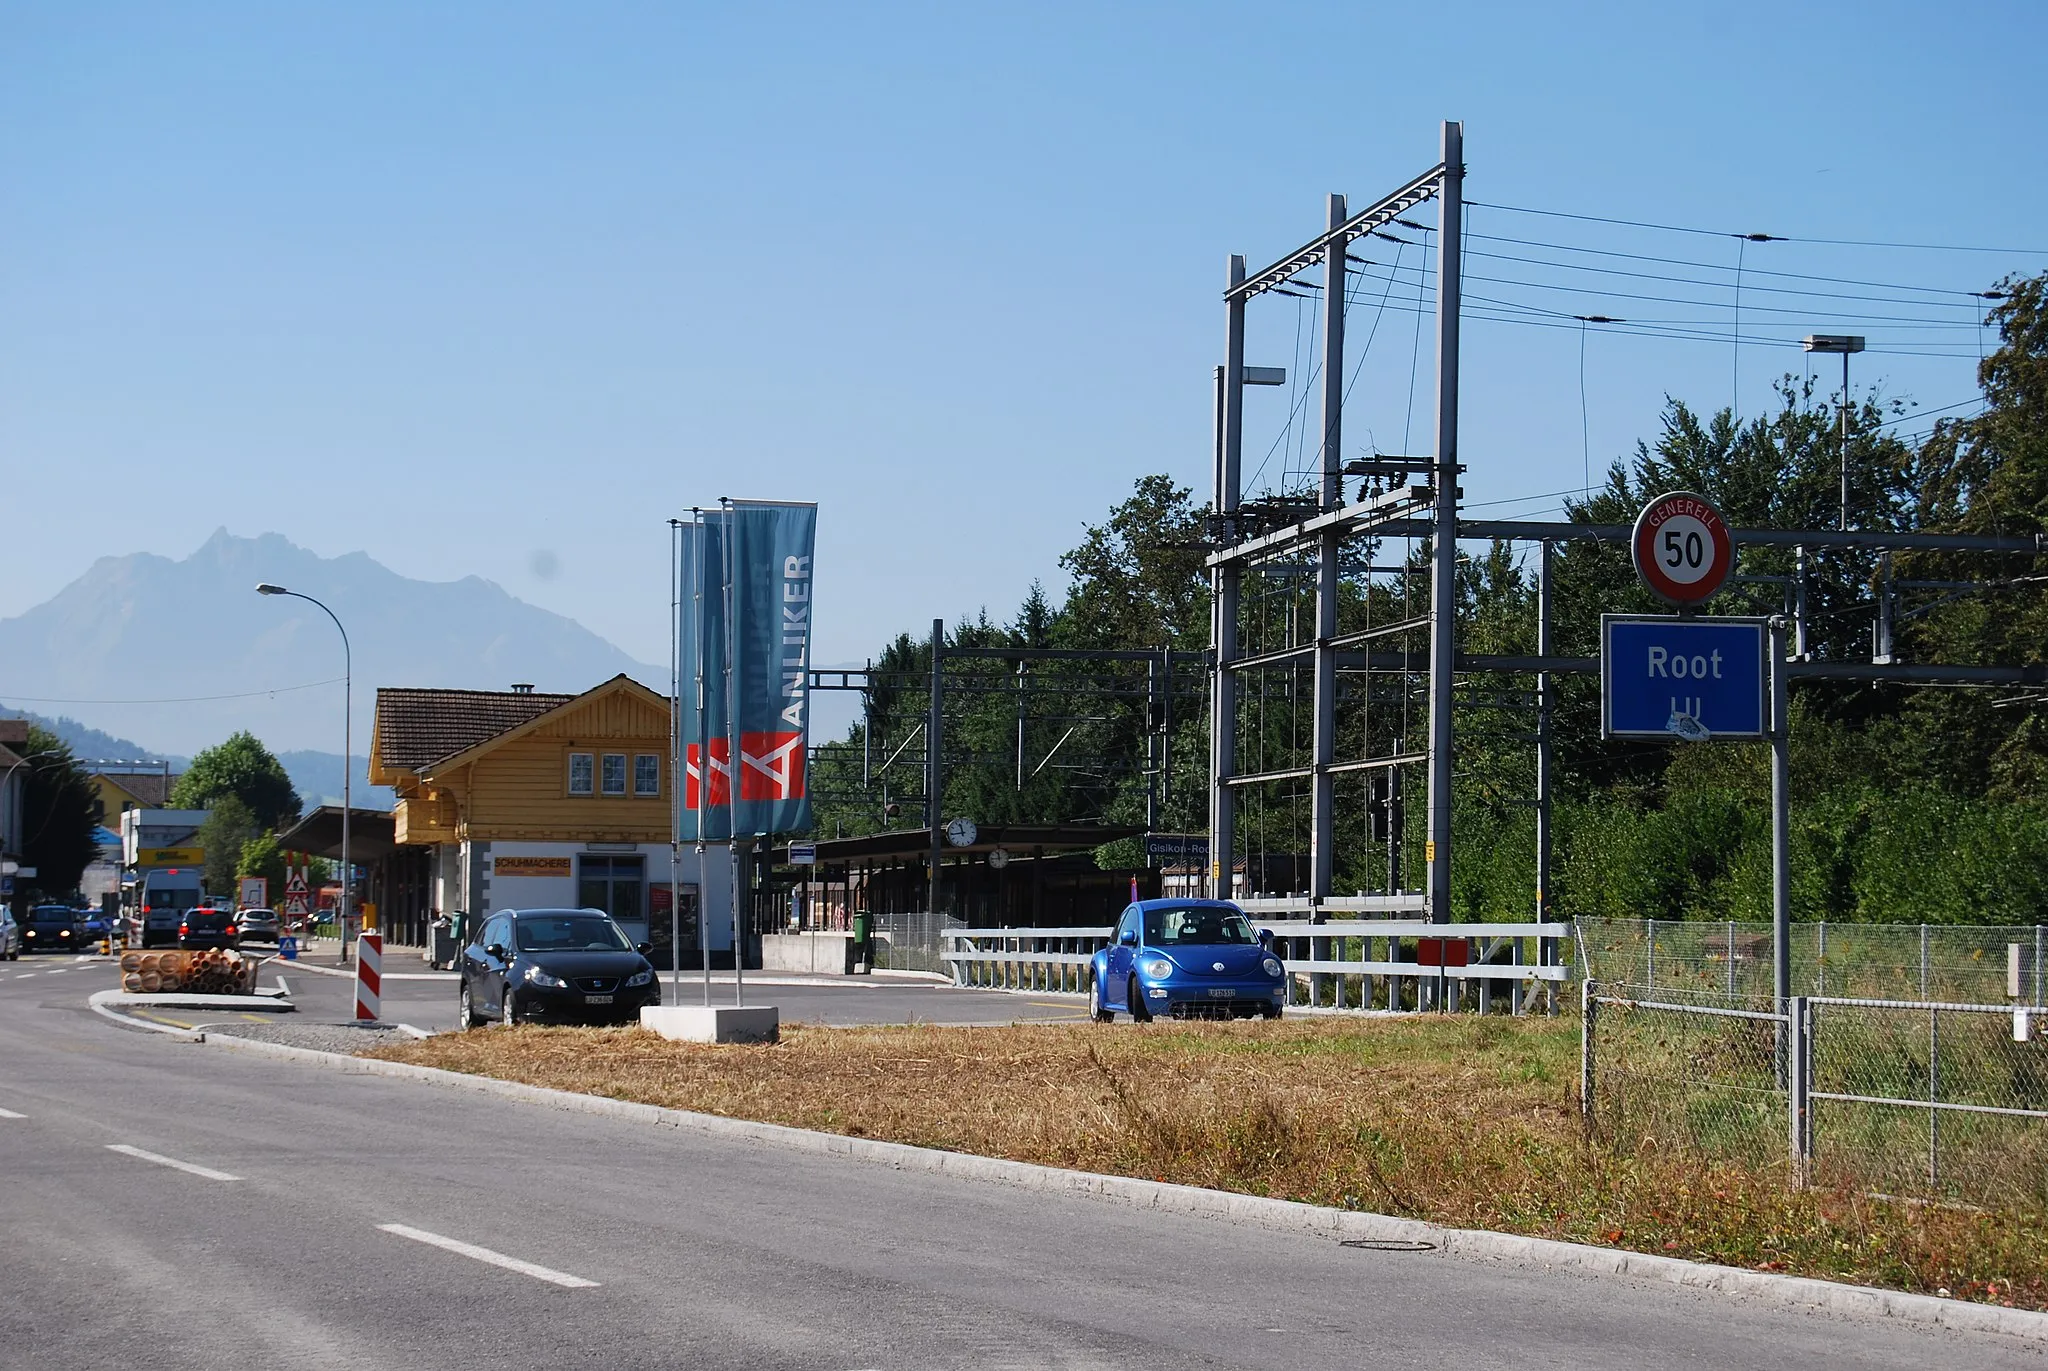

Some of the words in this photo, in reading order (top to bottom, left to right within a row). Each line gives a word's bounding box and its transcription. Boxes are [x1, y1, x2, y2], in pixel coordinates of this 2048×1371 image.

[1649, 500, 1716, 529] GENERELL
[1665, 532, 1703, 569] 50
[782, 554, 809, 728] ANLIKER
[1648, 646, 1723, 679] Root
[495, 858, 571, 868] SCHUHMACHEREI
[1150, 843, 1209, 854] Gisikon-Roo
